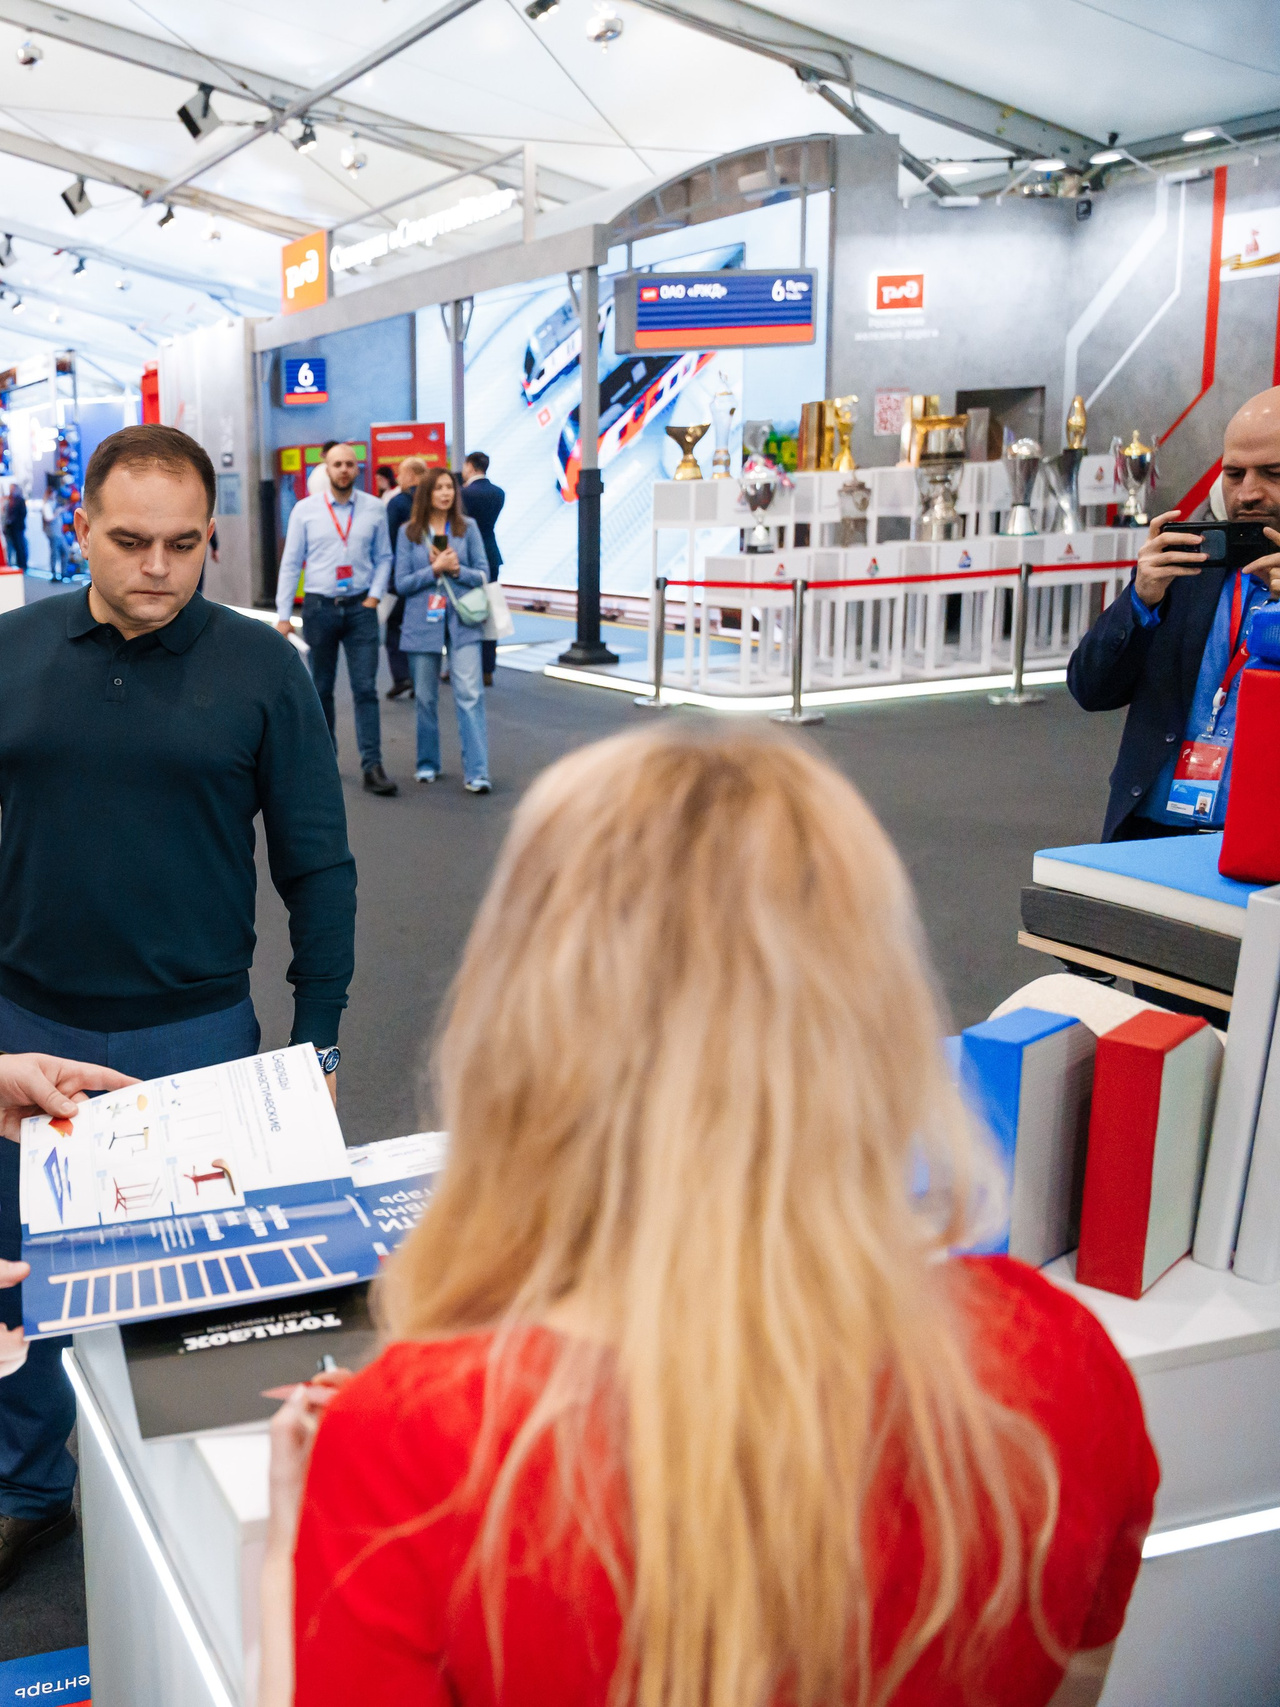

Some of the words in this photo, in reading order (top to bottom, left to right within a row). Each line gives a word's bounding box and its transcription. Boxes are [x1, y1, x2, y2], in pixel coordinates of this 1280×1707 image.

[771, 279, 786, 301] 6
[297, 362, 315, 387] 6
[184, 1314, 342, 1351] TOTALBOX
[14, 1674, 91, 1699] ентарь
